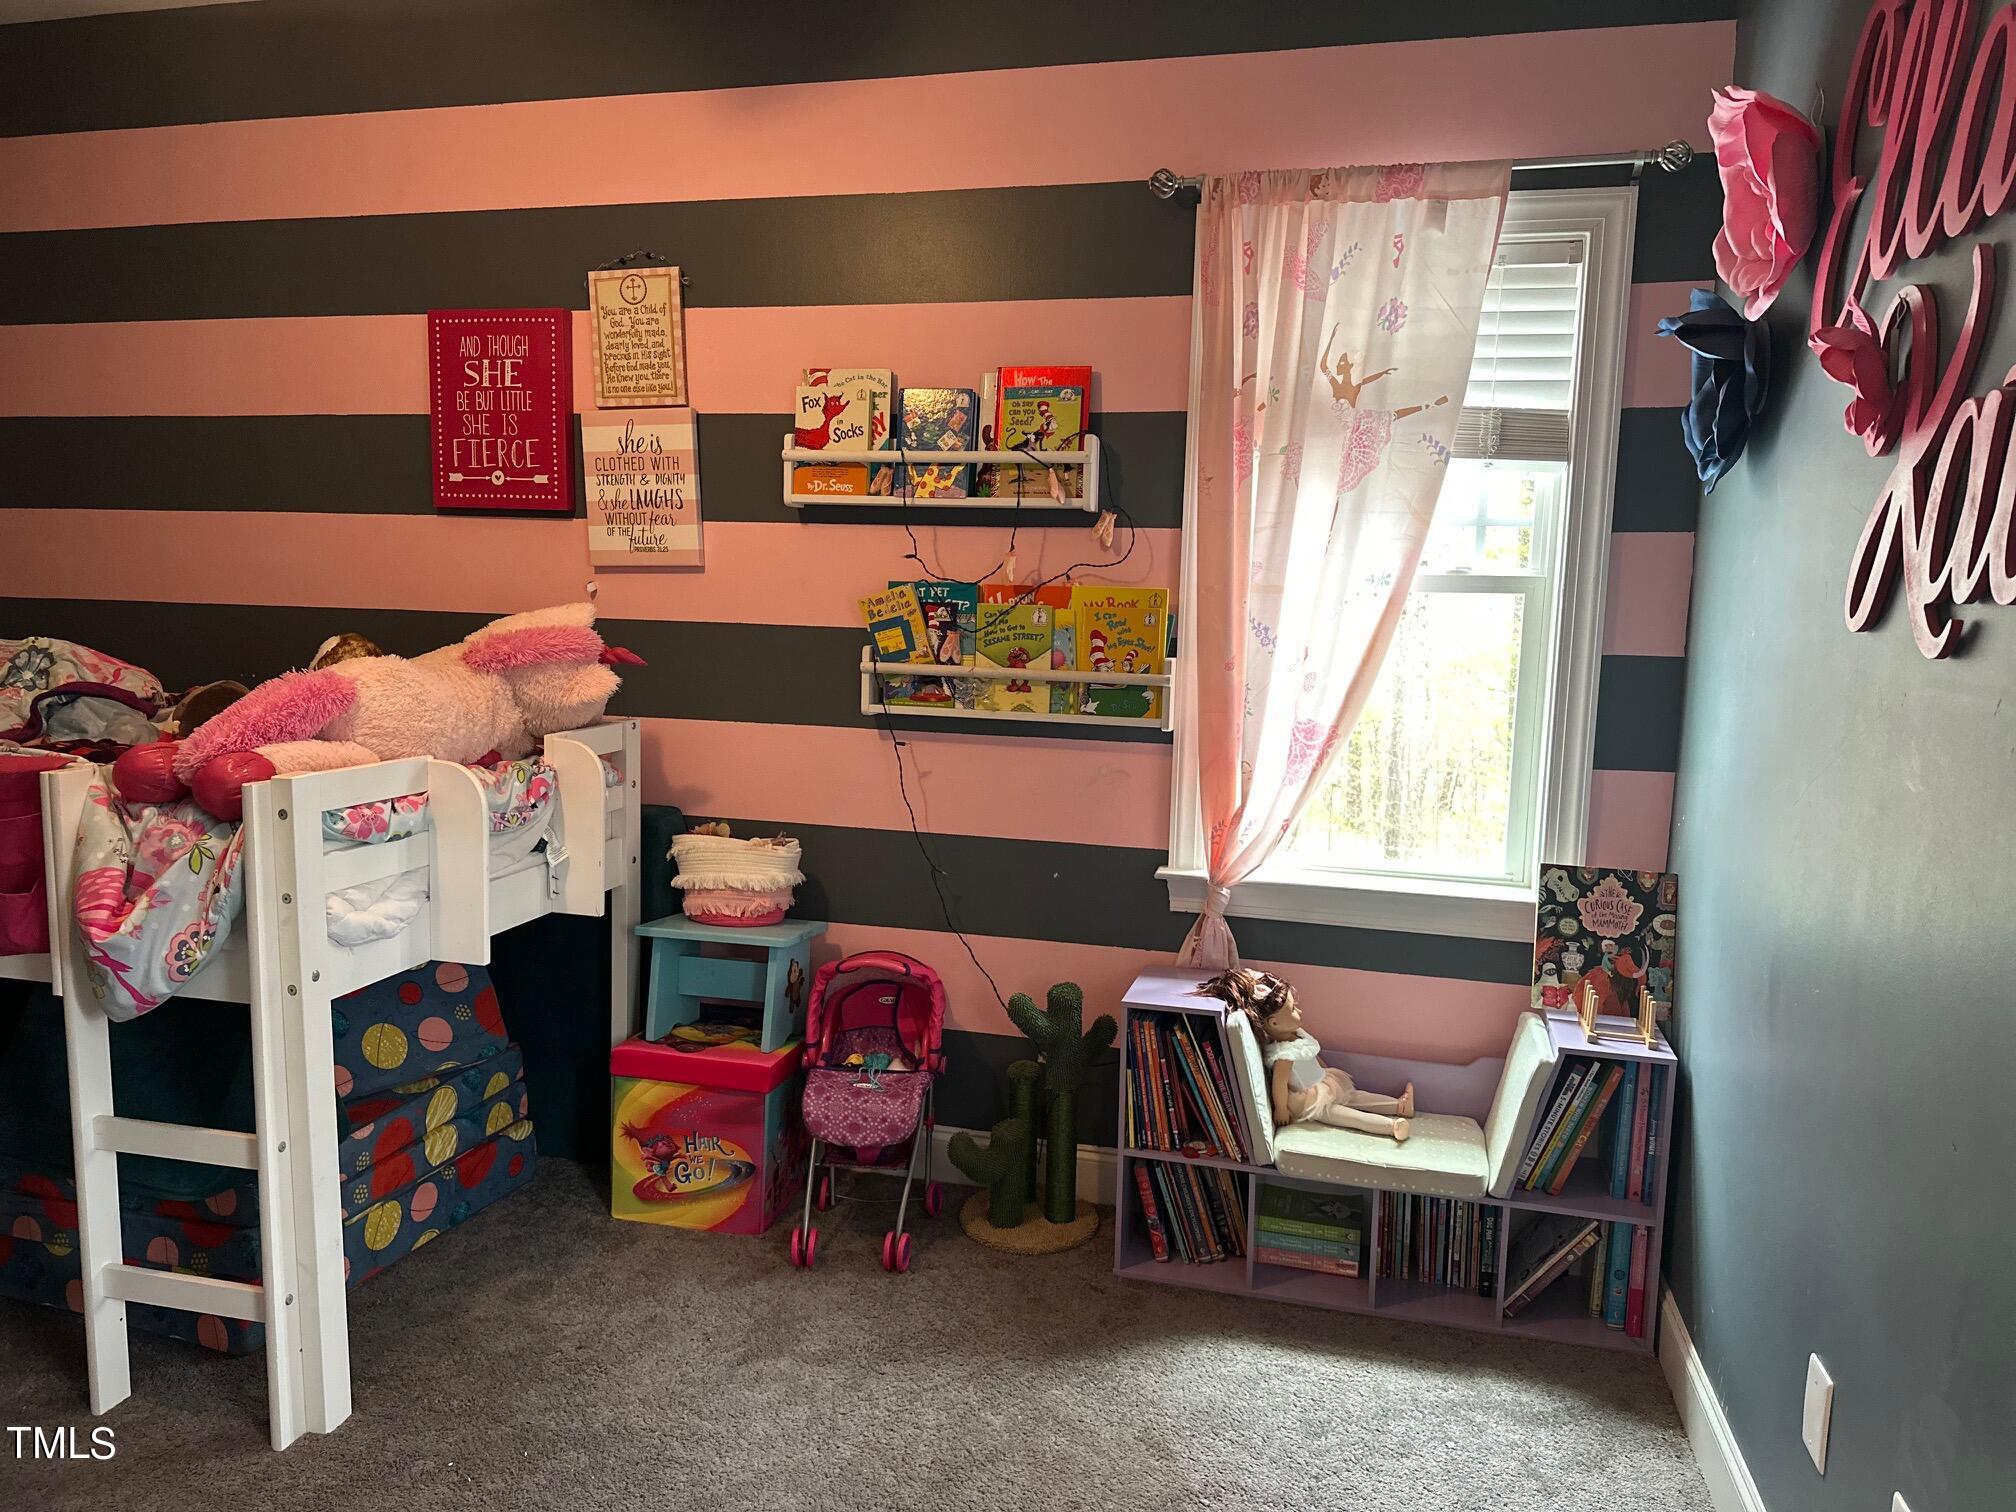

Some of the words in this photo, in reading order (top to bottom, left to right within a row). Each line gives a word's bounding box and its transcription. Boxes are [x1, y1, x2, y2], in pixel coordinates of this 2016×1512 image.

[601, 306, 617, 319] You
[618, 307, 632, 316] are
[633, 307, 640, 315] a
[658, 302, 667, 316] of
[646, 317, 660, 326] are
[604, 328, 643, 342] wonderfully
[459, 335, 481, 357] AND
[487, 334, 529, 357] THOUGH
[605, 340, 630, 352] dearly
[651, 338, 665, 348] and
[463, 358, 523, 388] SHE
[626, 361, 639, 372] God
[639, 361, 656, 371] made
[606, 373, 616, 384] He
[650, 371, 670, 380] there
[845, 375, 856, 383] Cat
[866, 374, 877, 383] the
[605, 385, 612, 394] is
[611, 385, 620, 394] no
[620, 384, 632, 393] one
[645, 383, 657, 392] like
[456, 390, 470, 412] BE
[475, 390, 495, 412] BUT
[500, 390, 533, 412] LITTLE
[801, 395, 822, 413] Fox
[462, 413, 491, 436] SHE
[502, 413, 518, 436] IS
[616, 418, 648, 456] she
[650, 433, 663, 456] is
[832, 423, 864, 443] Socks
[453, 438, 540, 468] FIERCE
[594, 456, 645, 472] CLOTHED
[649, 456, 680, 471] WITH
[595, 473, 635, 486] STRENGTH
[639, 473, 651, 485] &
[655, 473, 685, 486] DIGNITY
[814, 480, 828, 493] Dr.
[829, 479, 854, 493] Seuss
[629, 488, 684, 511] LAUGHS
[604, 511, 647, 526] WITHOUT
[648, 510, 678, 534] fear
[606, 527, 616, 537] OF
[618, 526, 631, 537] THE
[628, 524, 669, 554] future
[634, 545, 656, 553] PROVERBS
[867, 590, 907, 609] Amelia
[867, 600, 912, 620] Bedelia
[983, 635, 1011, 647] SESAME
[1012, 632, 1045, 642] STREET?
[1604, 886, 1615, 897] THE
[1585, 899, 1614, 914] CURIOUS
[1616, 899, 1632, 916] CASE
[1592, 919, 1629, 931] MAMMOTH
[684, 1131, 735, 1156] HAIR
[689, 1155, 704, 1164] WE
